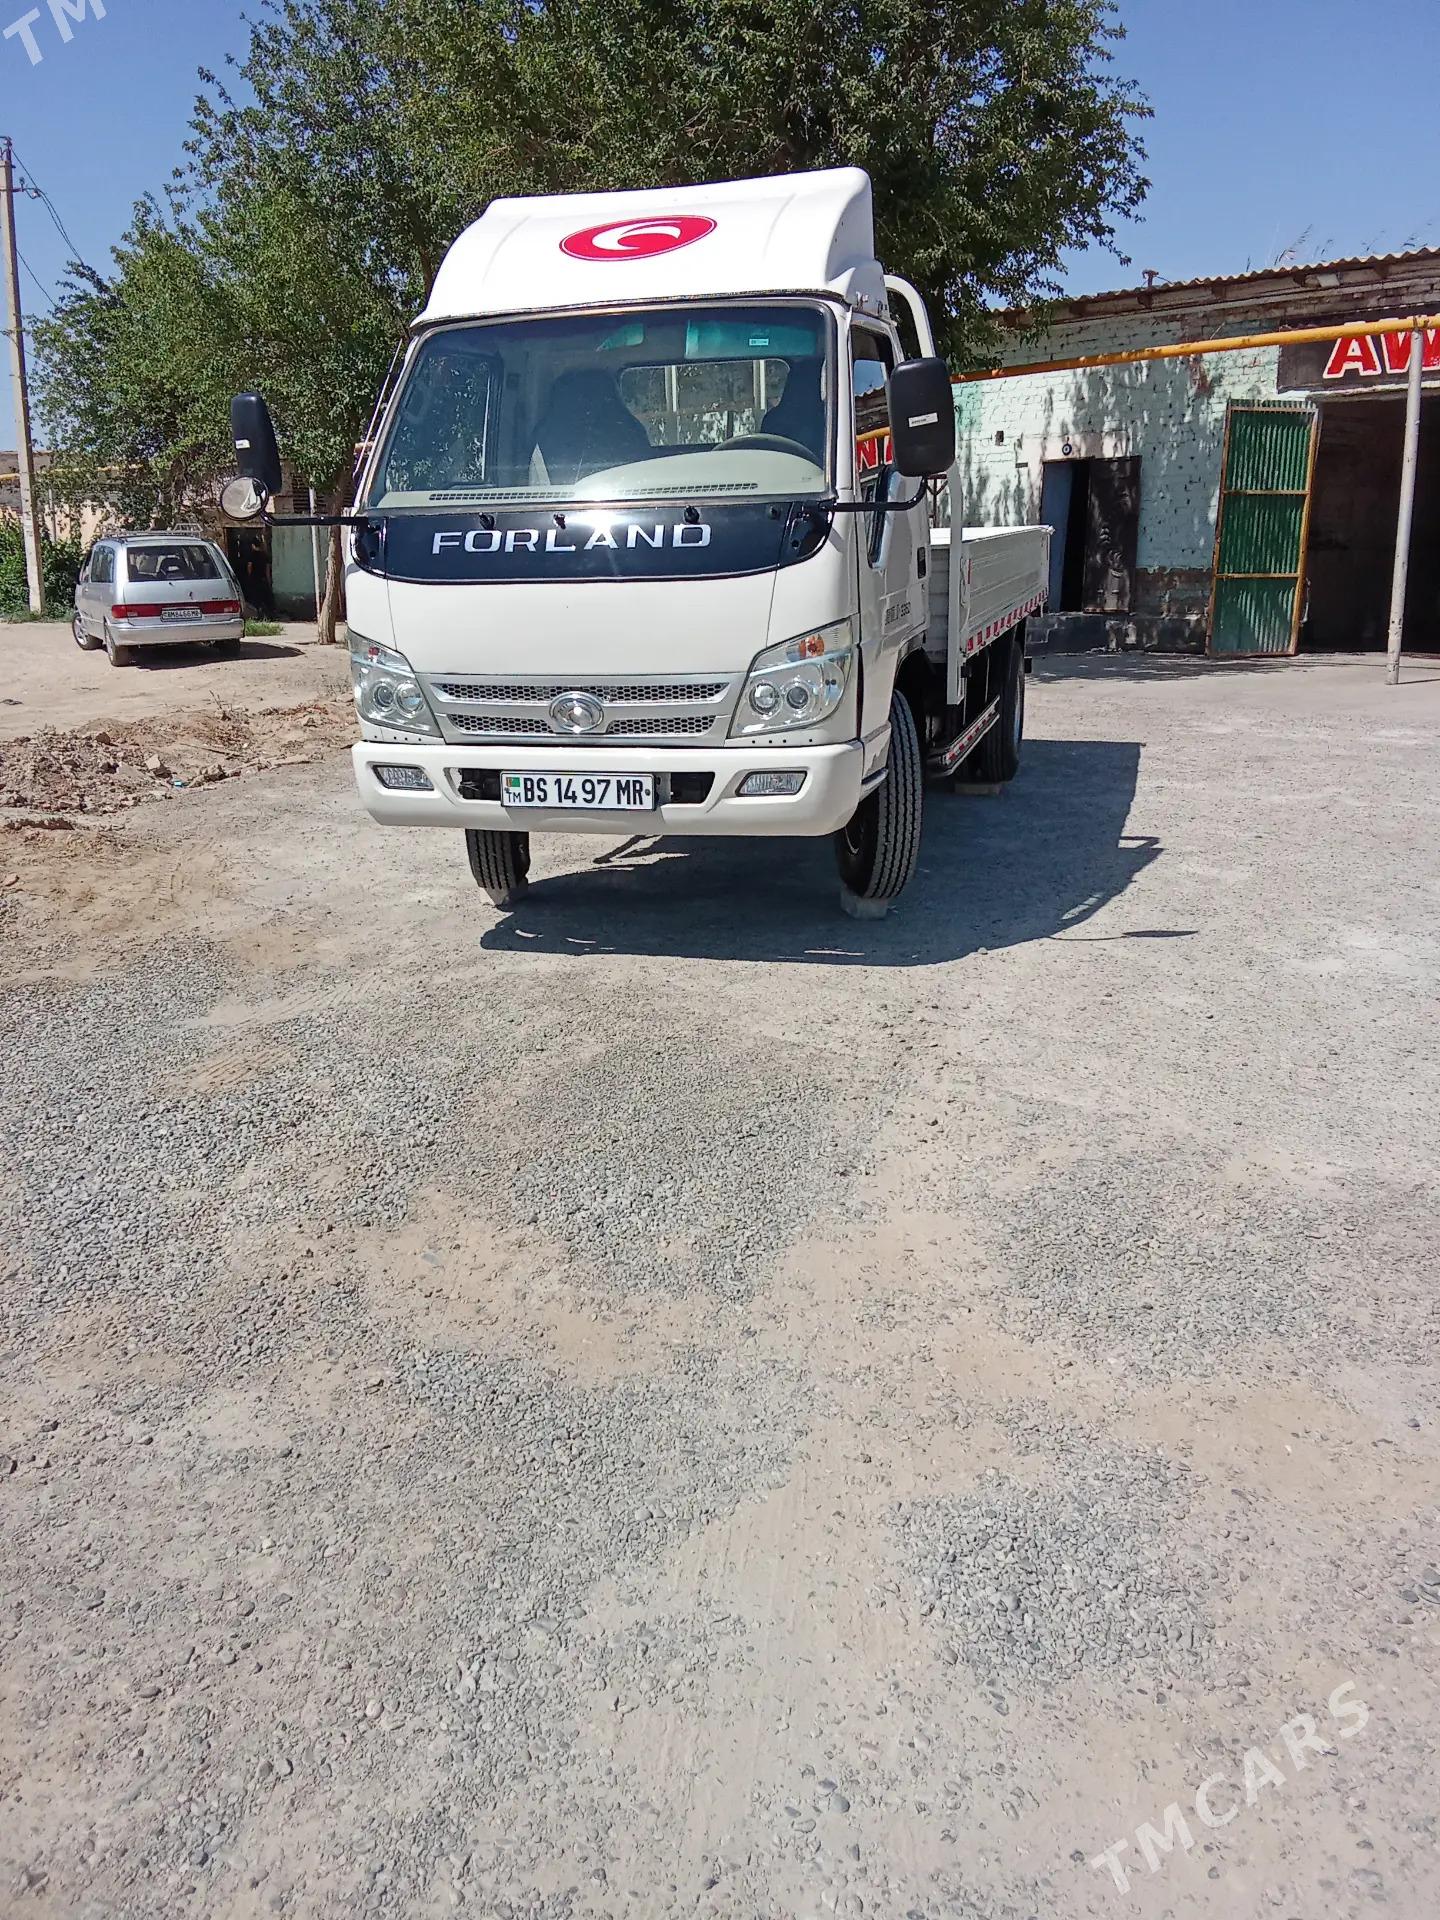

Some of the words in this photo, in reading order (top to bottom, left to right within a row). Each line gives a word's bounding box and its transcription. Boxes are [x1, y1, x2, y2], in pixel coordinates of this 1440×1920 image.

[432, 524, 711, 555] FORLAND
[506, 791, 521, 803] TM
[523, 777, 548, 803] BS
[554, 778, 611, 804] 1497
[616, 779, 643, 805] MR
